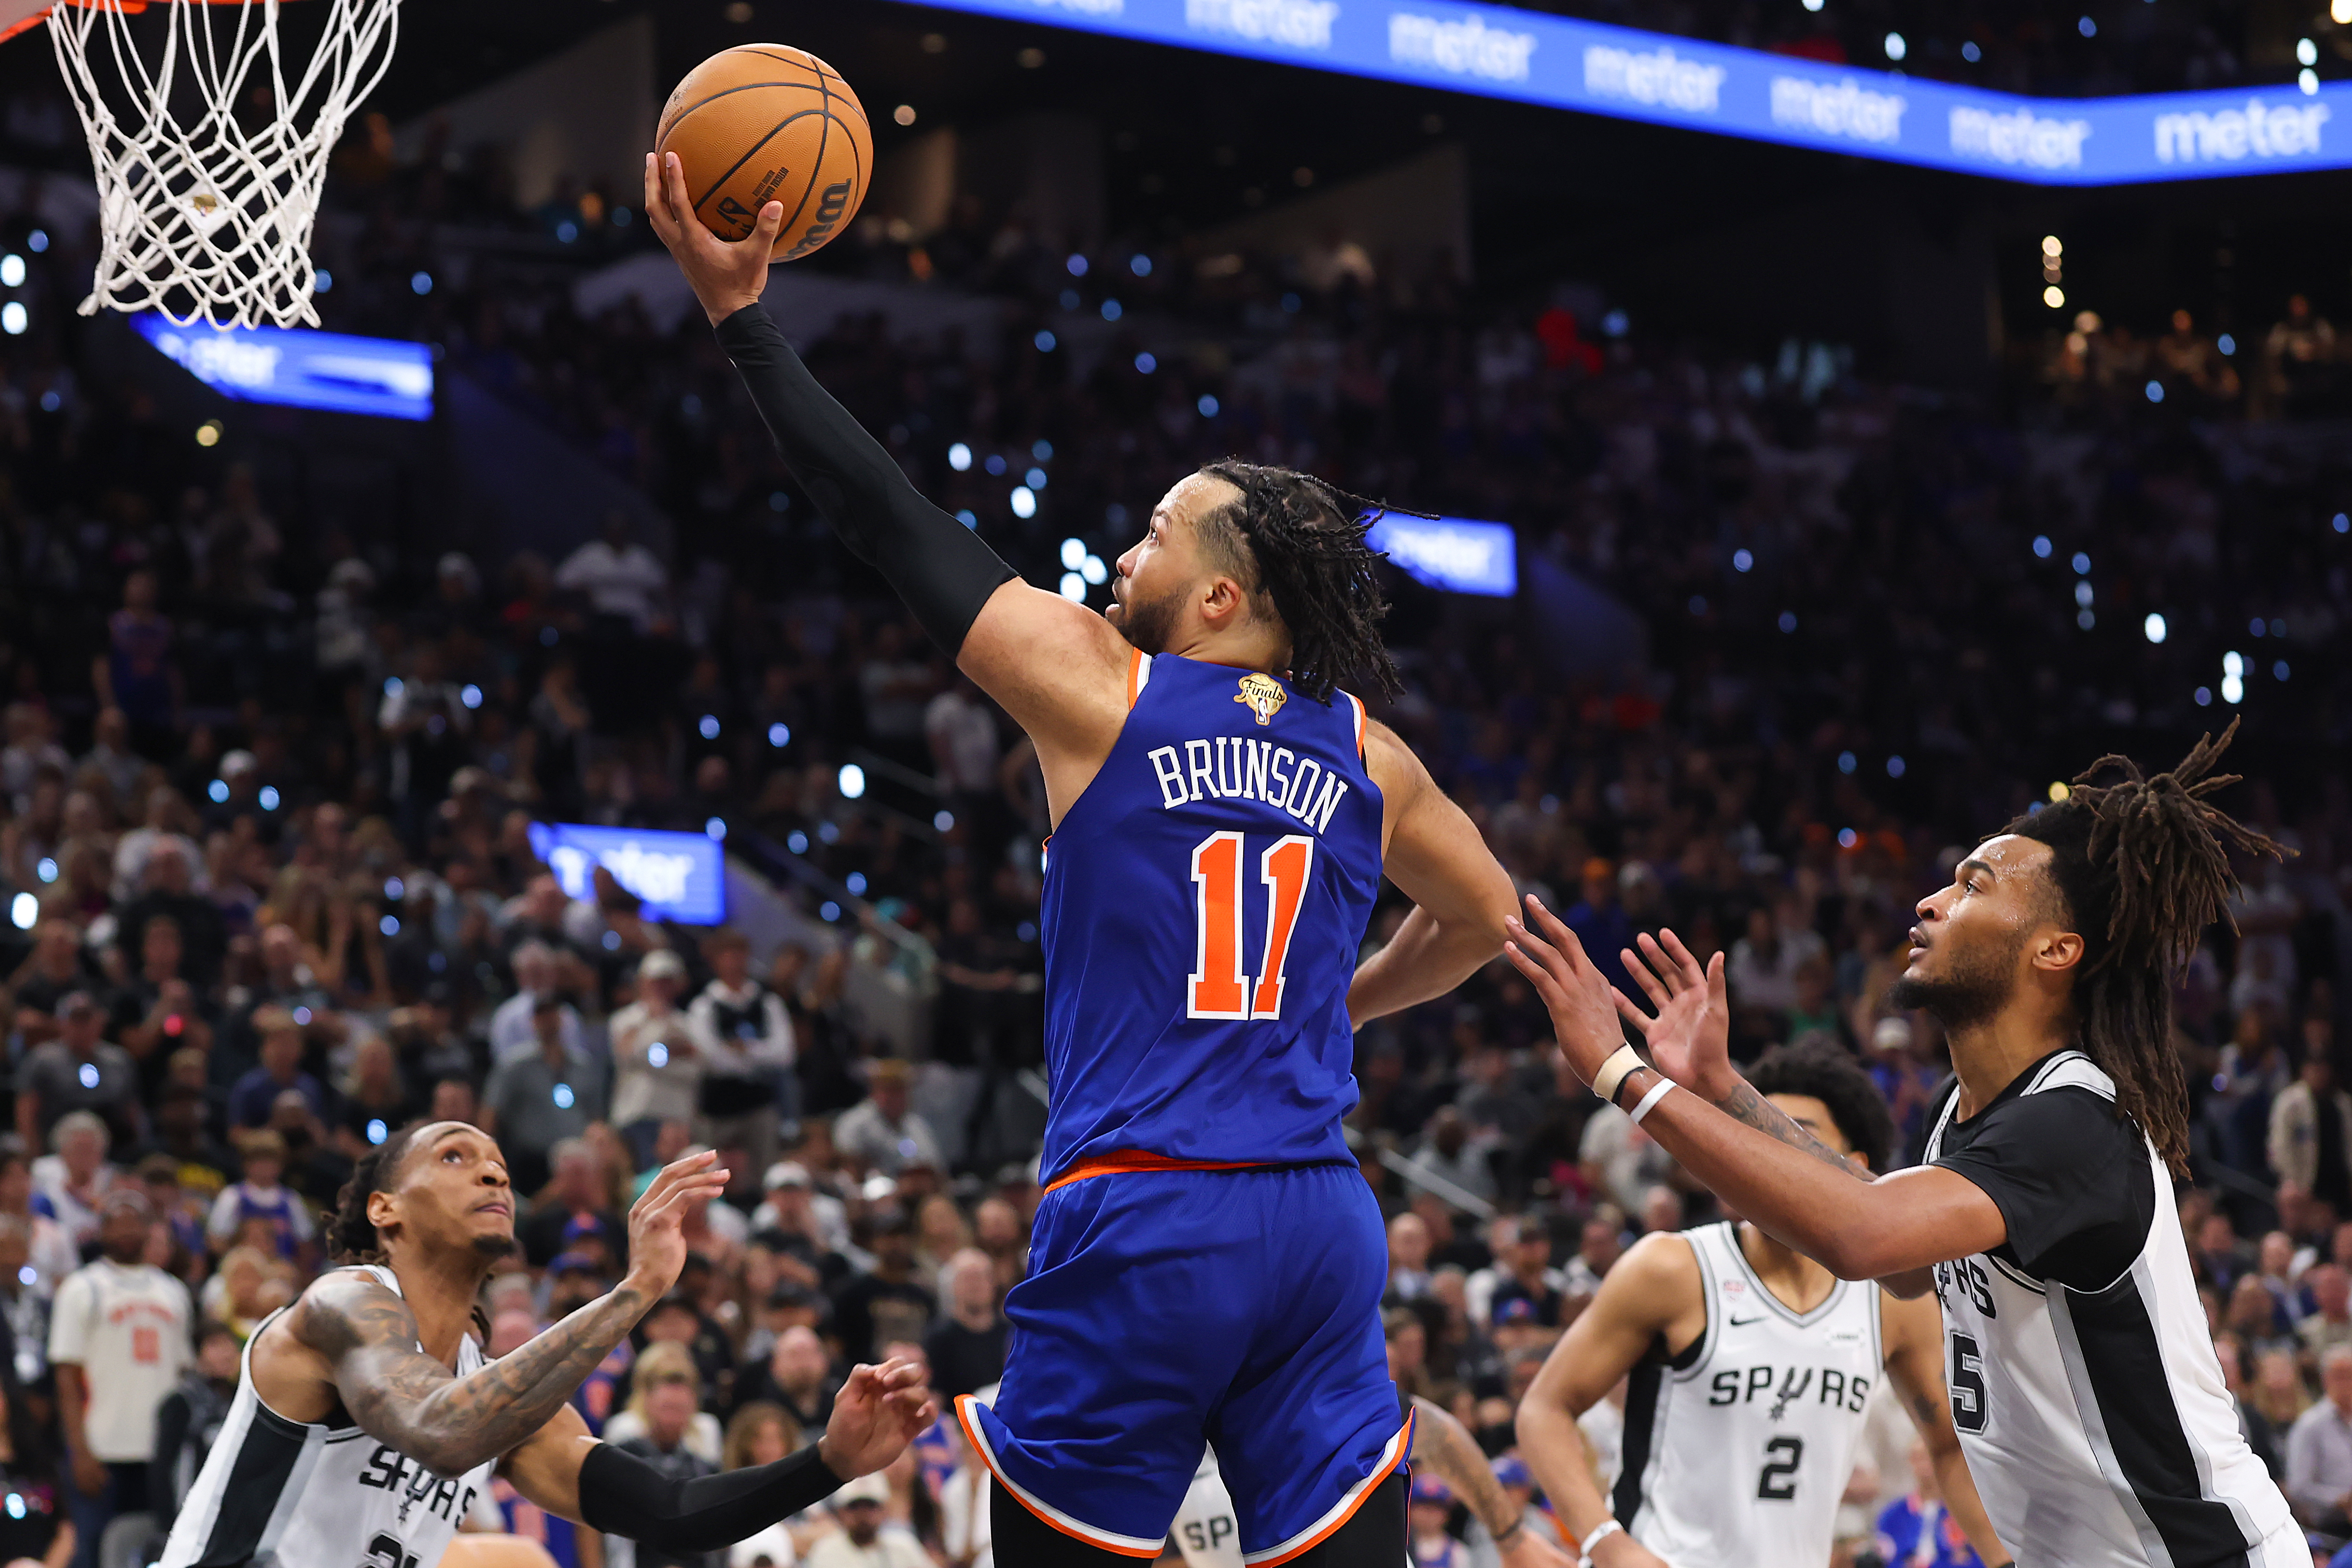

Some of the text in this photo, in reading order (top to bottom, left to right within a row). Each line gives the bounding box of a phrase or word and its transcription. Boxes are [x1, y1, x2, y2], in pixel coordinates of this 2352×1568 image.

[1771, 76, 1907, 144] meter
[1949, 107, 2092, 168] meter
[2155, 97, 2332, 163] meter
[1238, 679, 1285, 701] Finals
[1147, 737, 1349, 835] BRUNSON
[1186, 831, 1314, 1021] 11
[1709, 1366, 1870, 1422] SPURS
[1949, 1330, 1990, 1436] 5
[1757, 1436, 1803, 1501] 2
